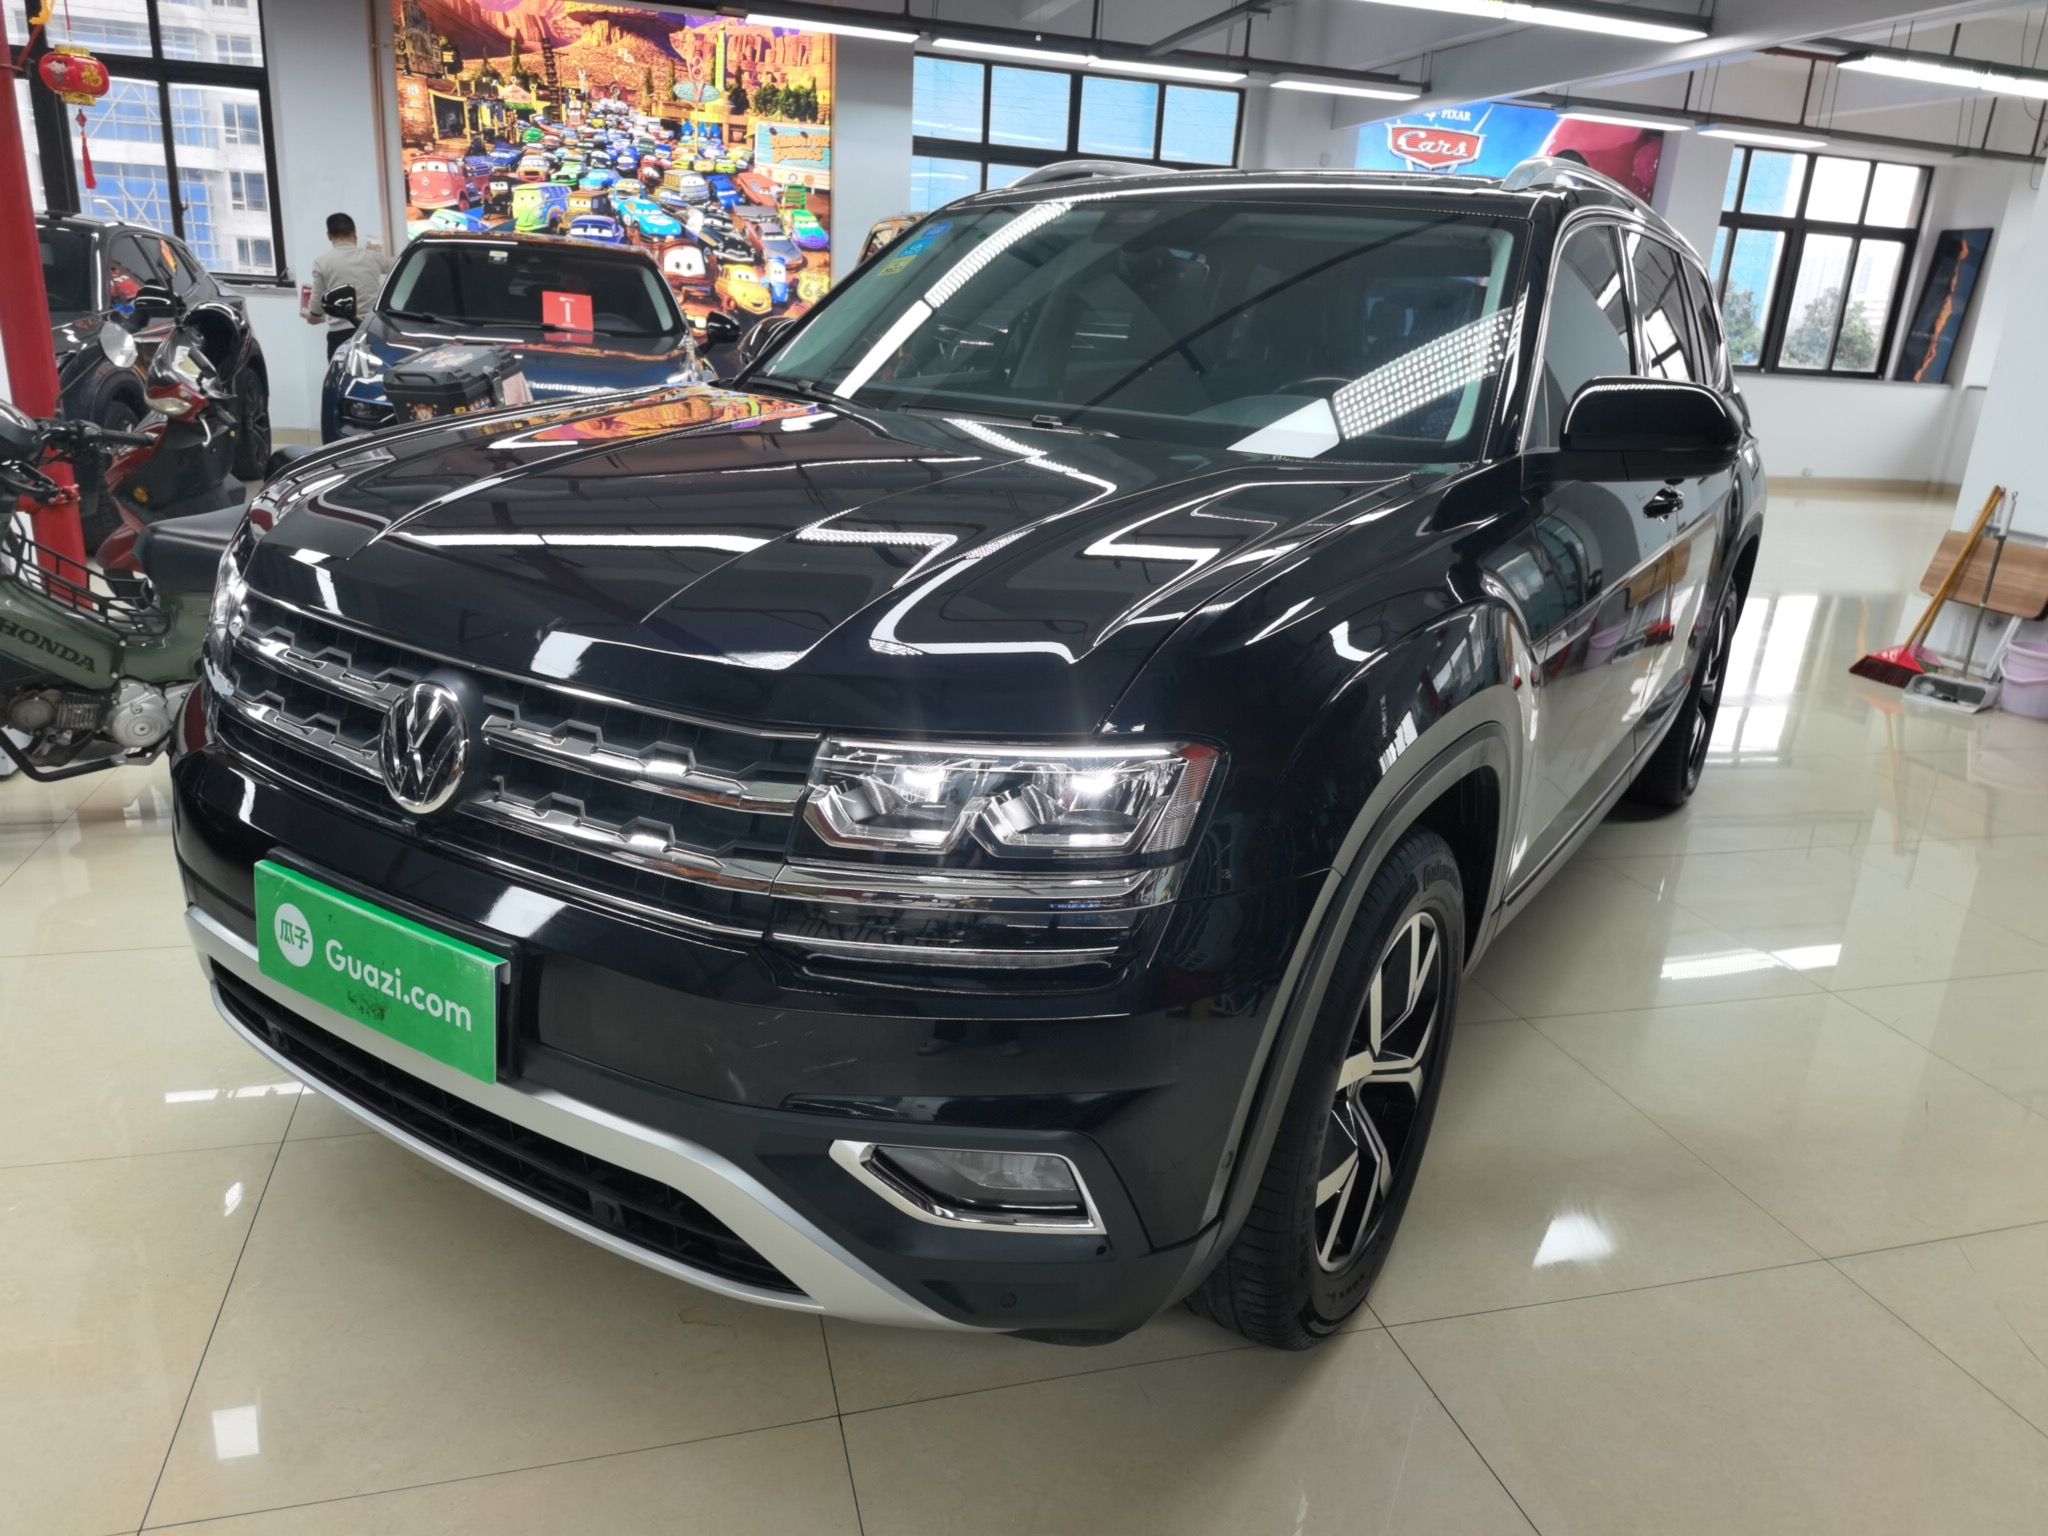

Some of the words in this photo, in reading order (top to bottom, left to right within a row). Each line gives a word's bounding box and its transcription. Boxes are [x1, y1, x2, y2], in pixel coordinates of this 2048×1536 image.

[1441, 109, 1472, 122] PIXAR
[1397, 130, 1469, 157] Cars
[0, 616, 97, 674] HONDA
[278, 918, 310, 951] 瓜子
[324, 938, 473, 1033] Guazi.com
